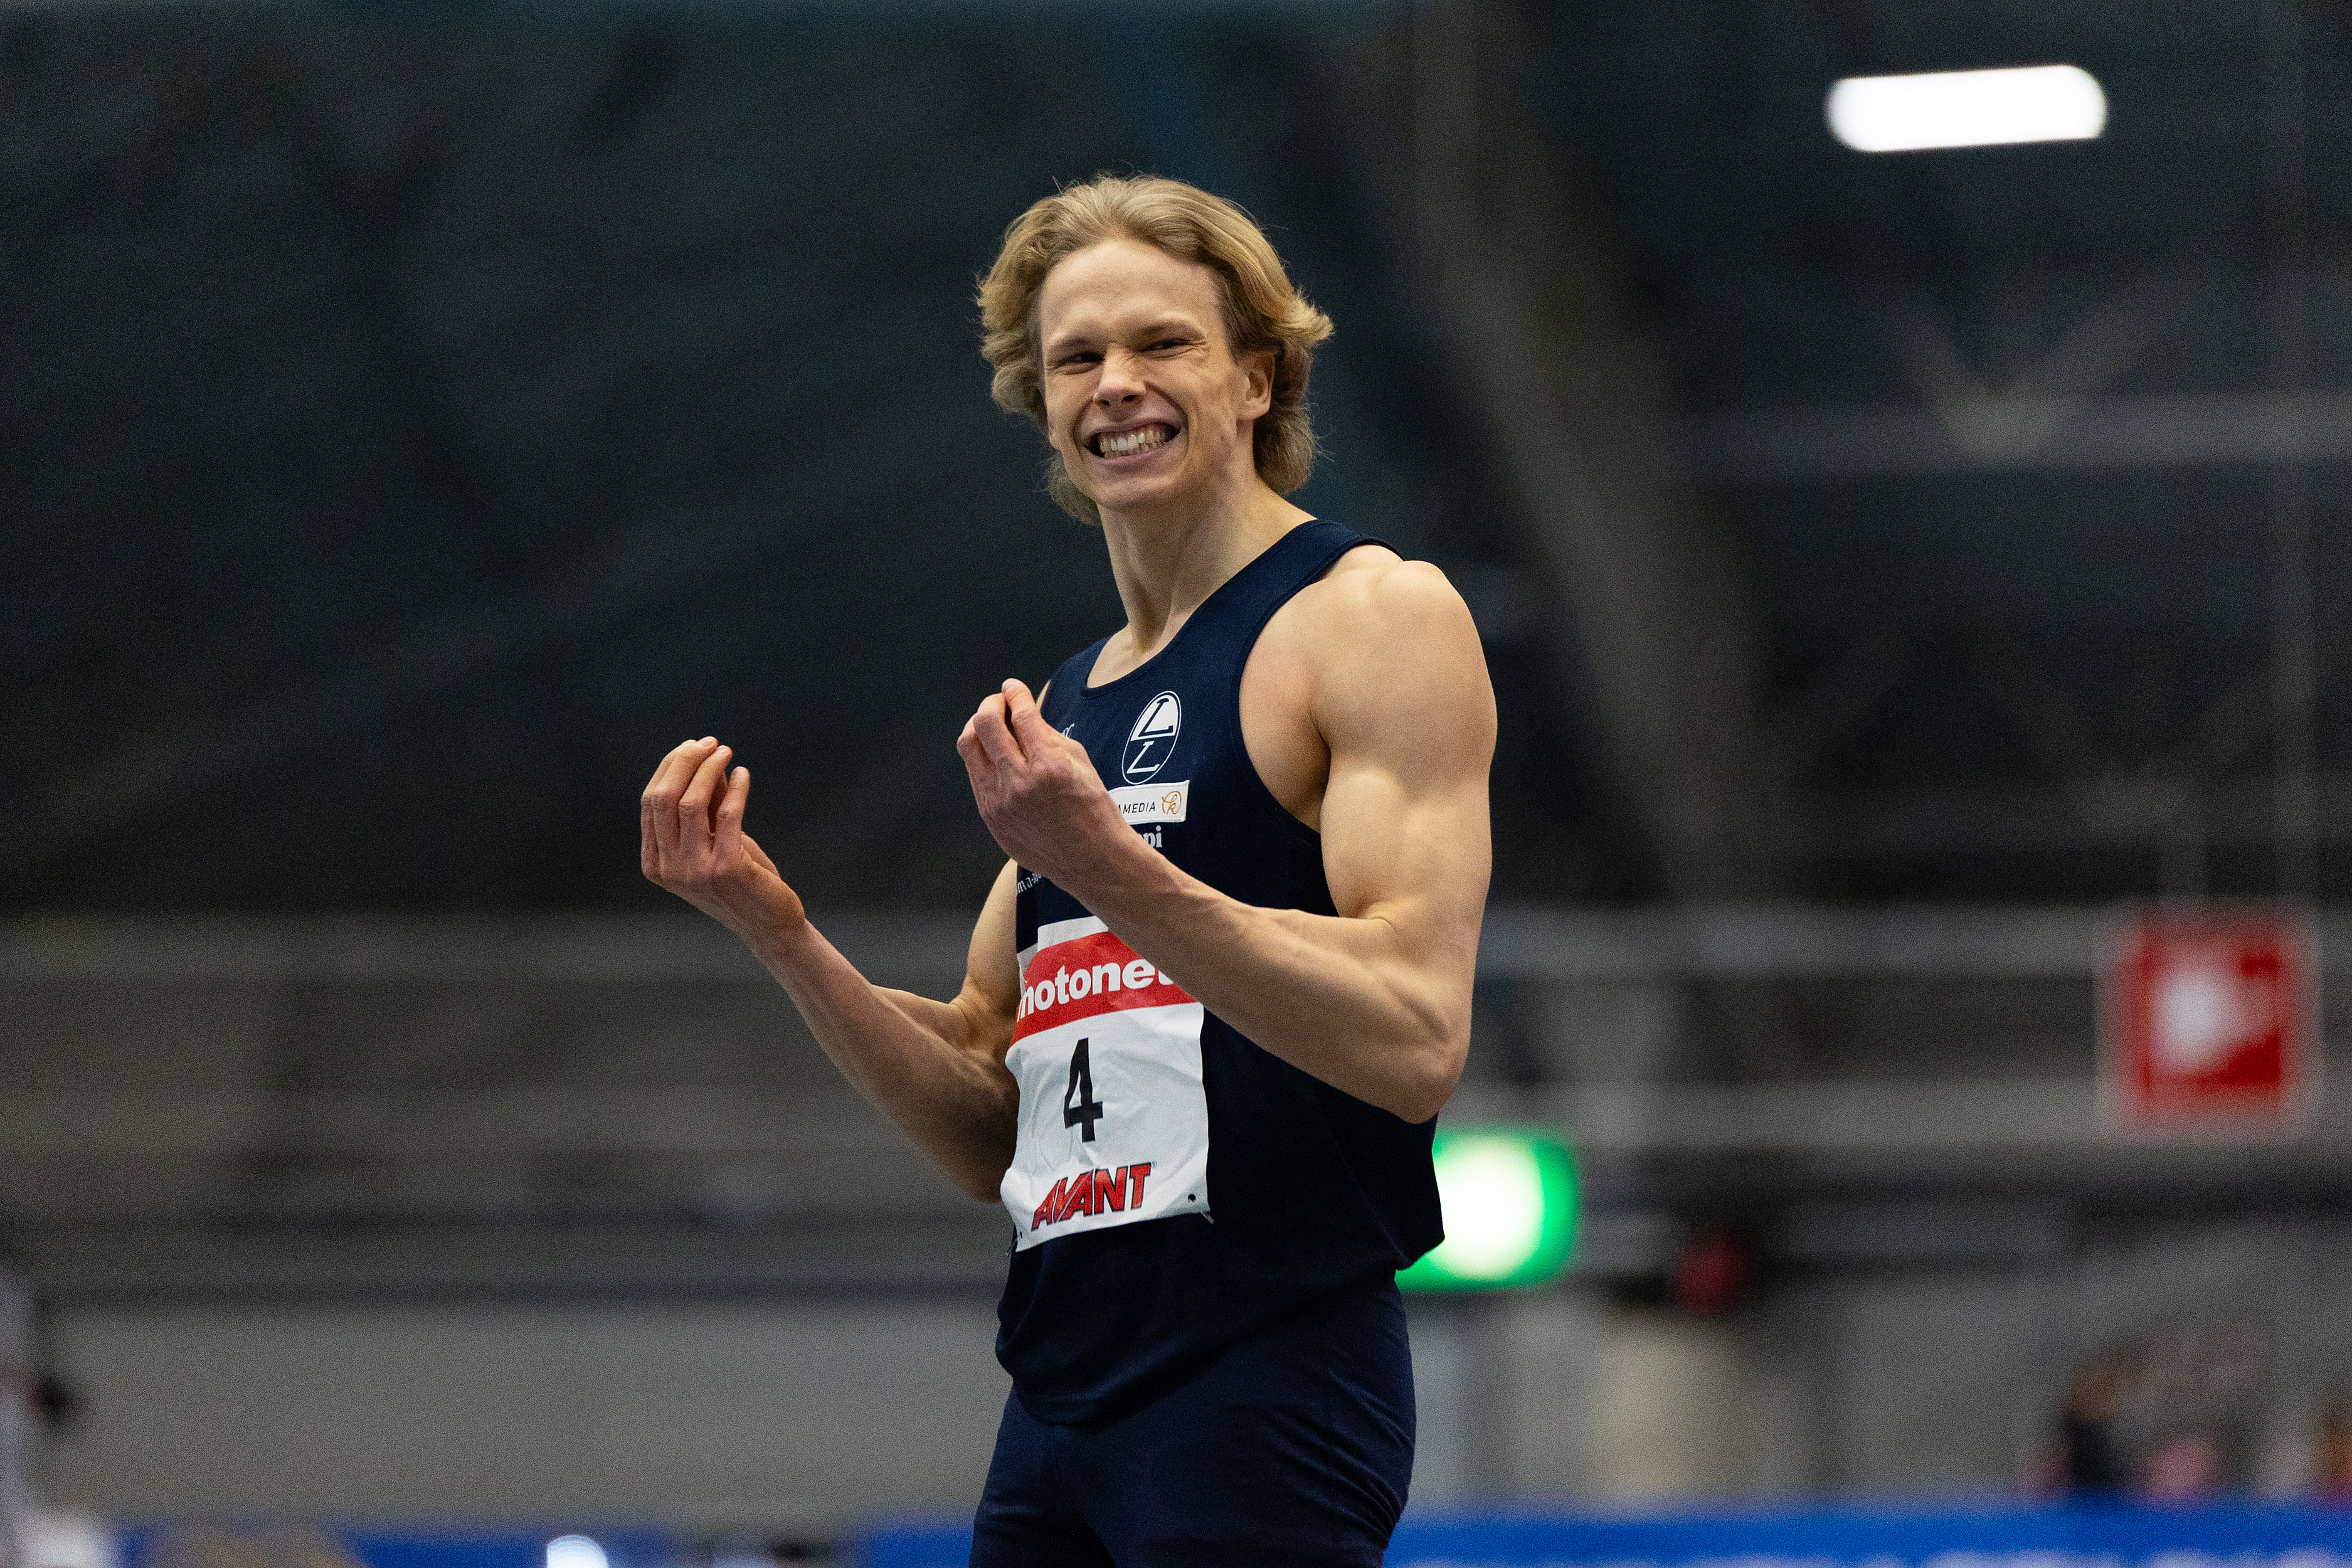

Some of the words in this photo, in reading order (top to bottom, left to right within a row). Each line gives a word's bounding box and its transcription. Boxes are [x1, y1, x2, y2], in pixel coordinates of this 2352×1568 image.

[1139, 825, 1162, 848] pi
[1063, 1037, 1103, 1143] 4
[1030, 1162, 1152, 1232] AVANT
